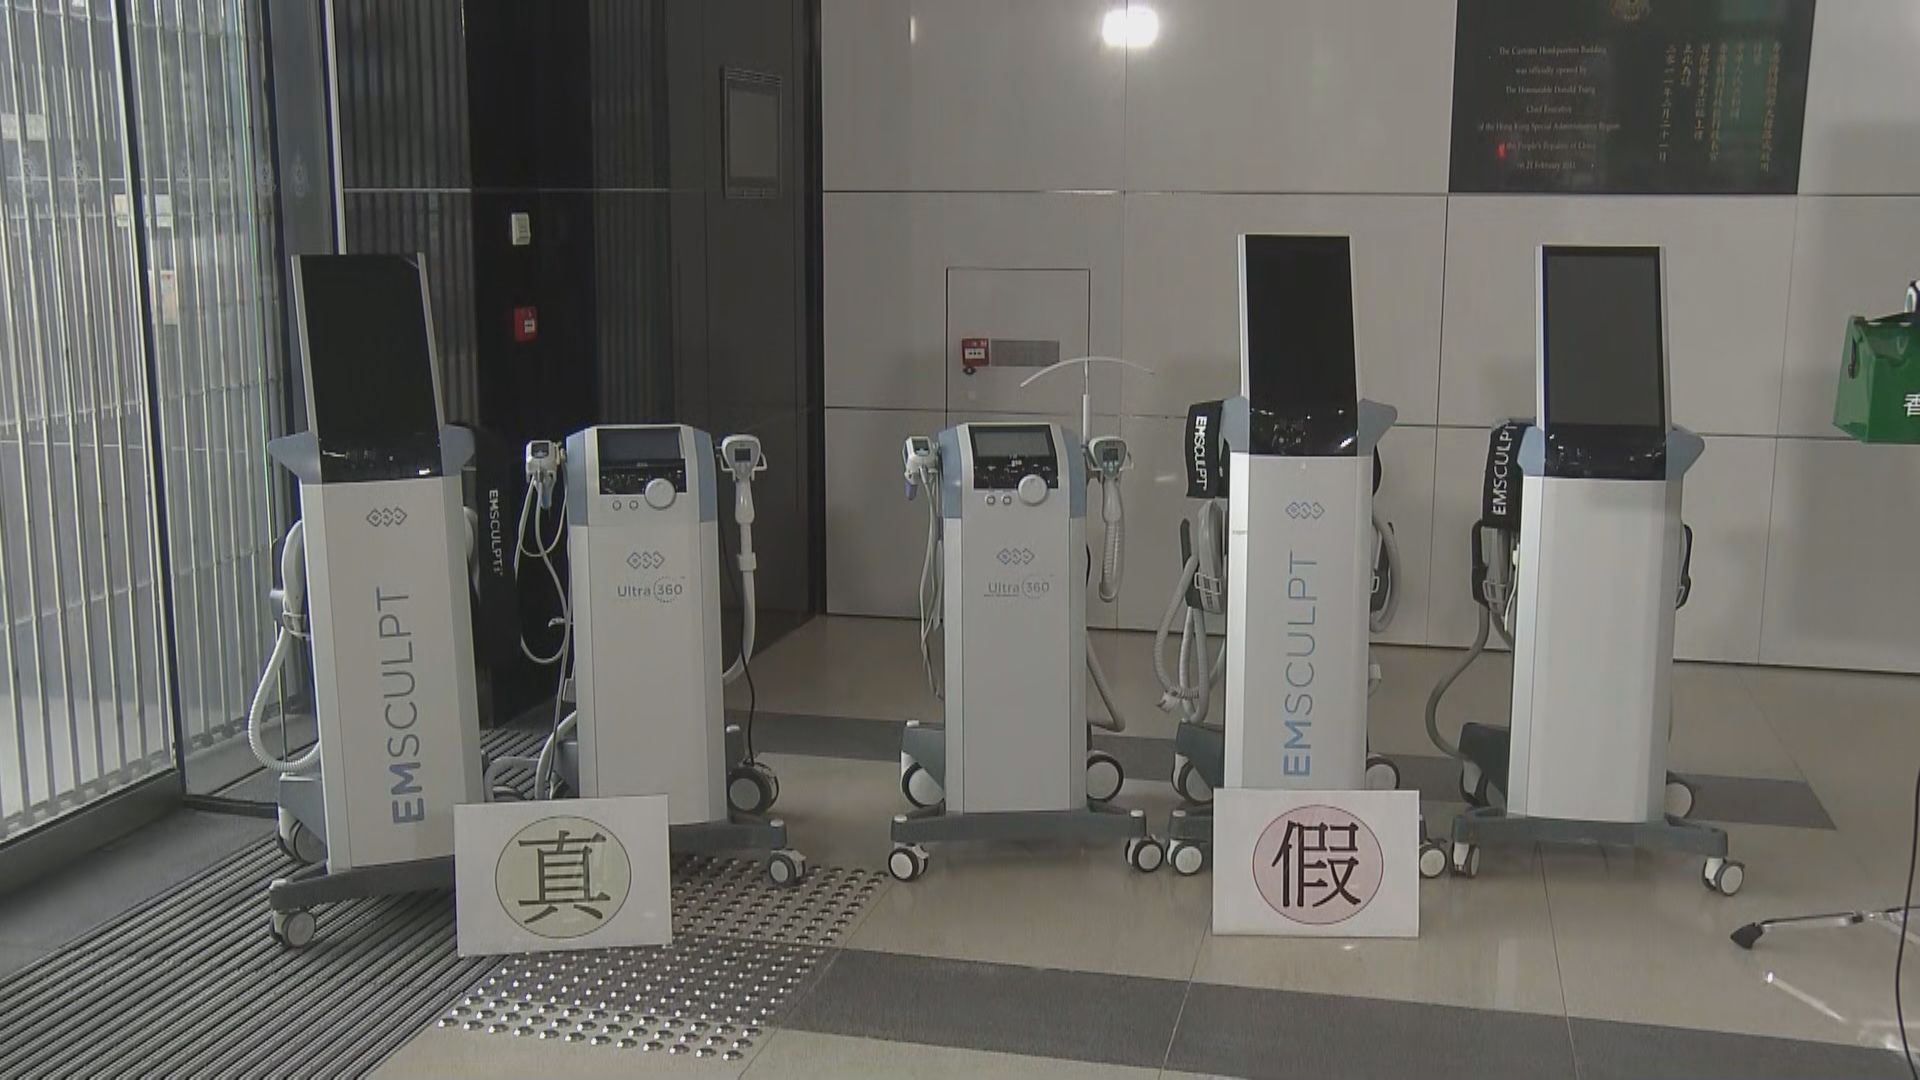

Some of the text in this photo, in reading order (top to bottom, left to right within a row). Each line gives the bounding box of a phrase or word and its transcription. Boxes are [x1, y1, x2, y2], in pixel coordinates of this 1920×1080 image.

[1193, 416, 1208, 491] EMSCULPT
[617, 584, 683, 598] Ultra 360
[988, 581, 1050, 594] Ultra 360
[377, 586, 425, 824] EMSCULPT
[1283, 550, 1318, 777] EMSCULPT
[518, 830, 611, 924] 真
[1272, 820, 1361, 907] 假
